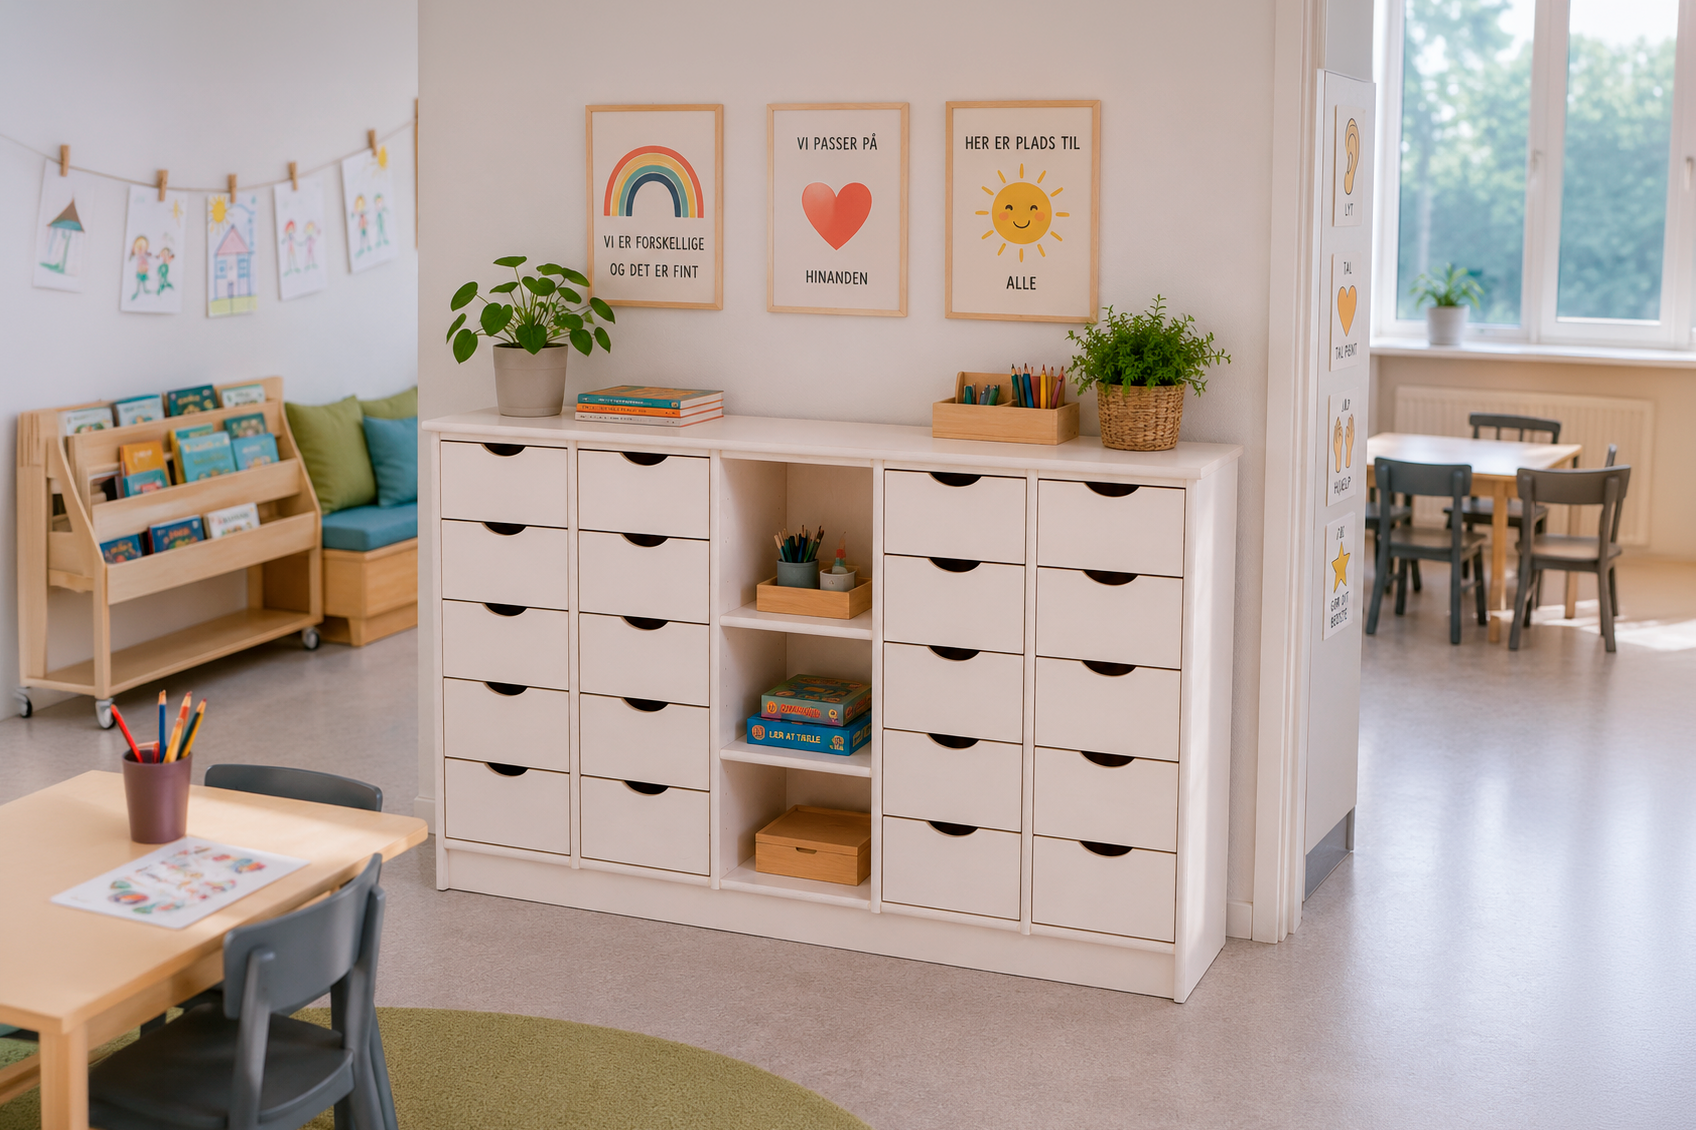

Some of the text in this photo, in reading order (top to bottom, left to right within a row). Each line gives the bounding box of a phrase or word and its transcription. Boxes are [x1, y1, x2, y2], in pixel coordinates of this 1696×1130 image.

[796, 132, 878, 151] VI PASSER PÅ
[965, 135, 1081, 150] HER ER PLADS TIL
[603, 235, 705, 251] VI ER FORSKELLIGE
[609, 263, 699, 280] OG DET ER FINT
[805, 270, 868, 286] HINANDEN
[1006, 276, 1037, 291] ALLE
